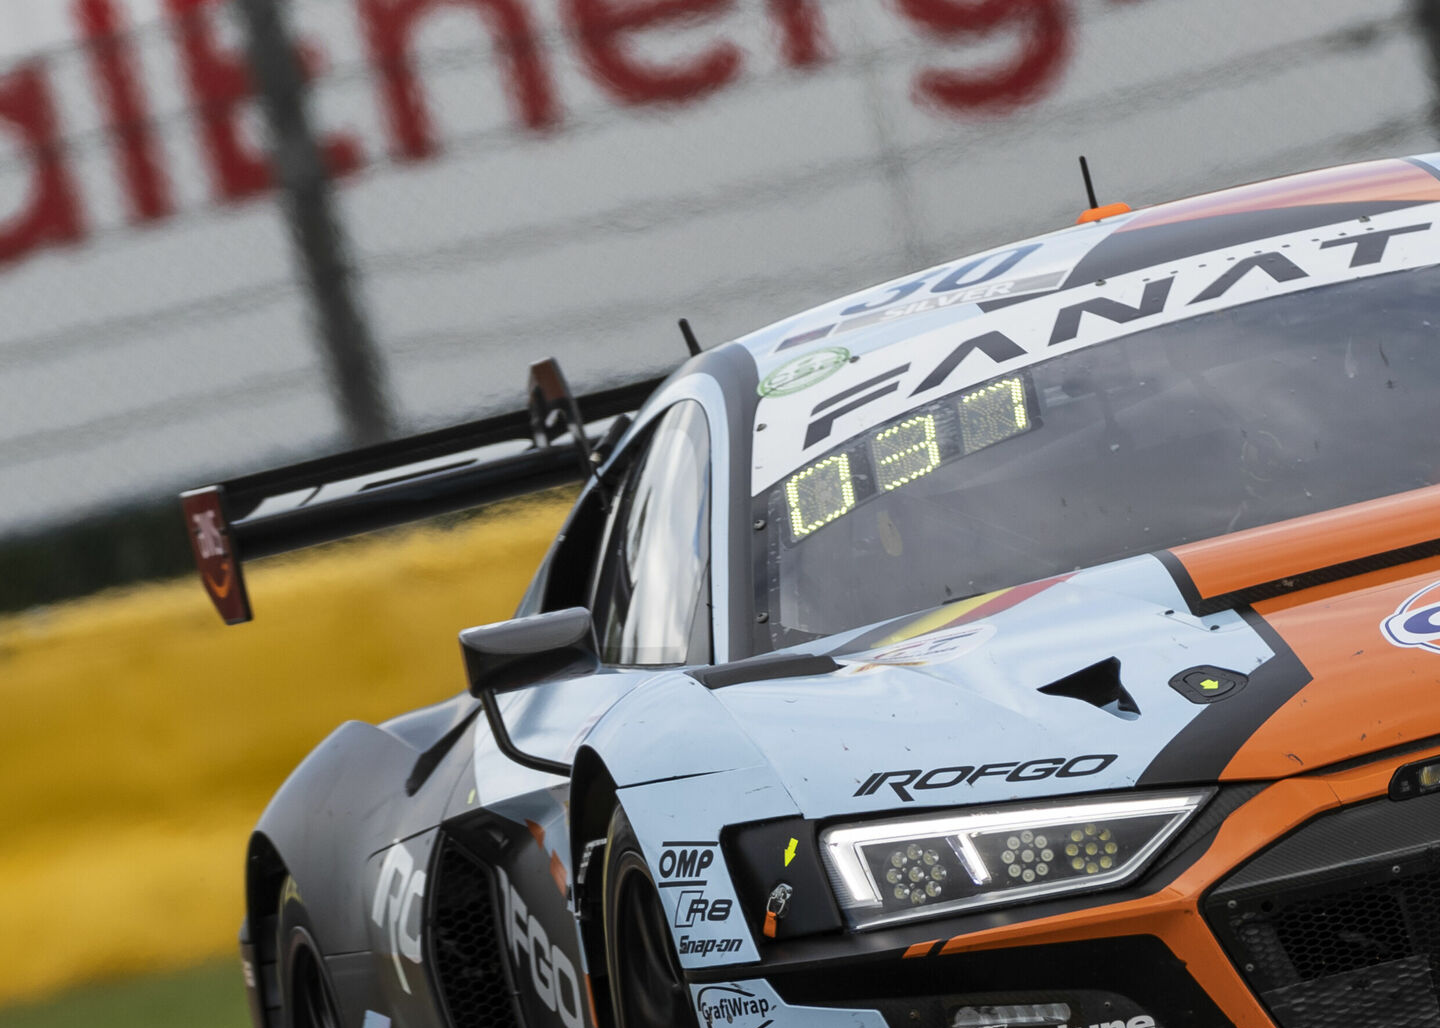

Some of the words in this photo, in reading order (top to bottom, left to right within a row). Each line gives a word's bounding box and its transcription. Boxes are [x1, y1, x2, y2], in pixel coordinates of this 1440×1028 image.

[883, 281, 1017, 320] SILVER
[659, 849, 714, 878] OMP
[680, 935, 743, 957] Snap-on
[702, 997, 769, 1020] GrafiWrap
